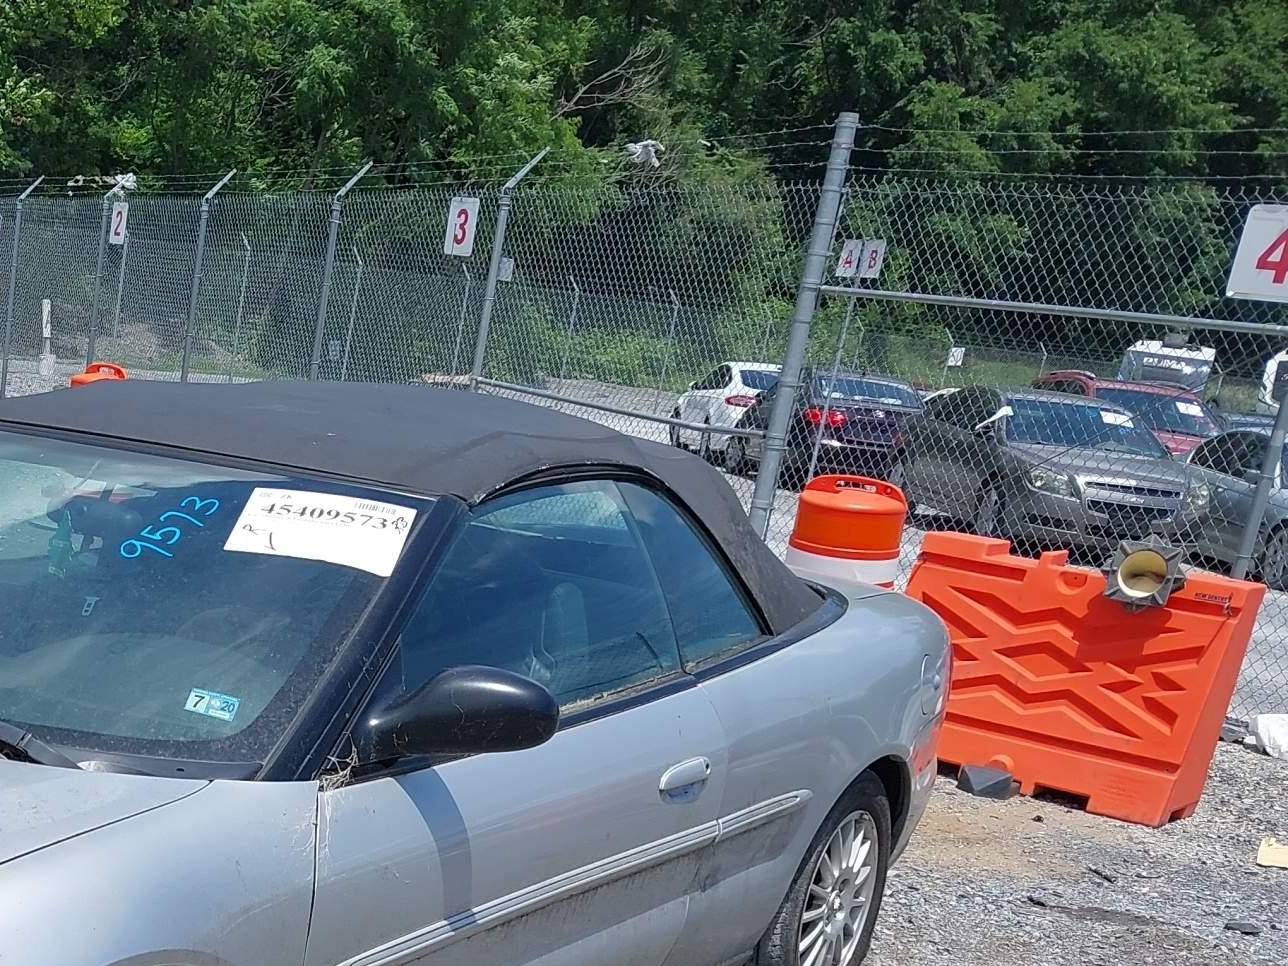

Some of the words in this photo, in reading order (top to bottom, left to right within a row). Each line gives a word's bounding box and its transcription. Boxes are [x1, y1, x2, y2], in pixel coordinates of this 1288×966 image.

[114, 210, 123, 236] 2
[454, 208, 469, 245] 3
[842, 250, 853, 268] A
[868, 249, 878, 269] B
[1255, 226, 1288, 284] 4
[120, 496, 220, 558] 9573
[261, 503, 389, 530] 45409573
[193, 694, 205, 708] 7
[220, 700, 236, 713] 20
